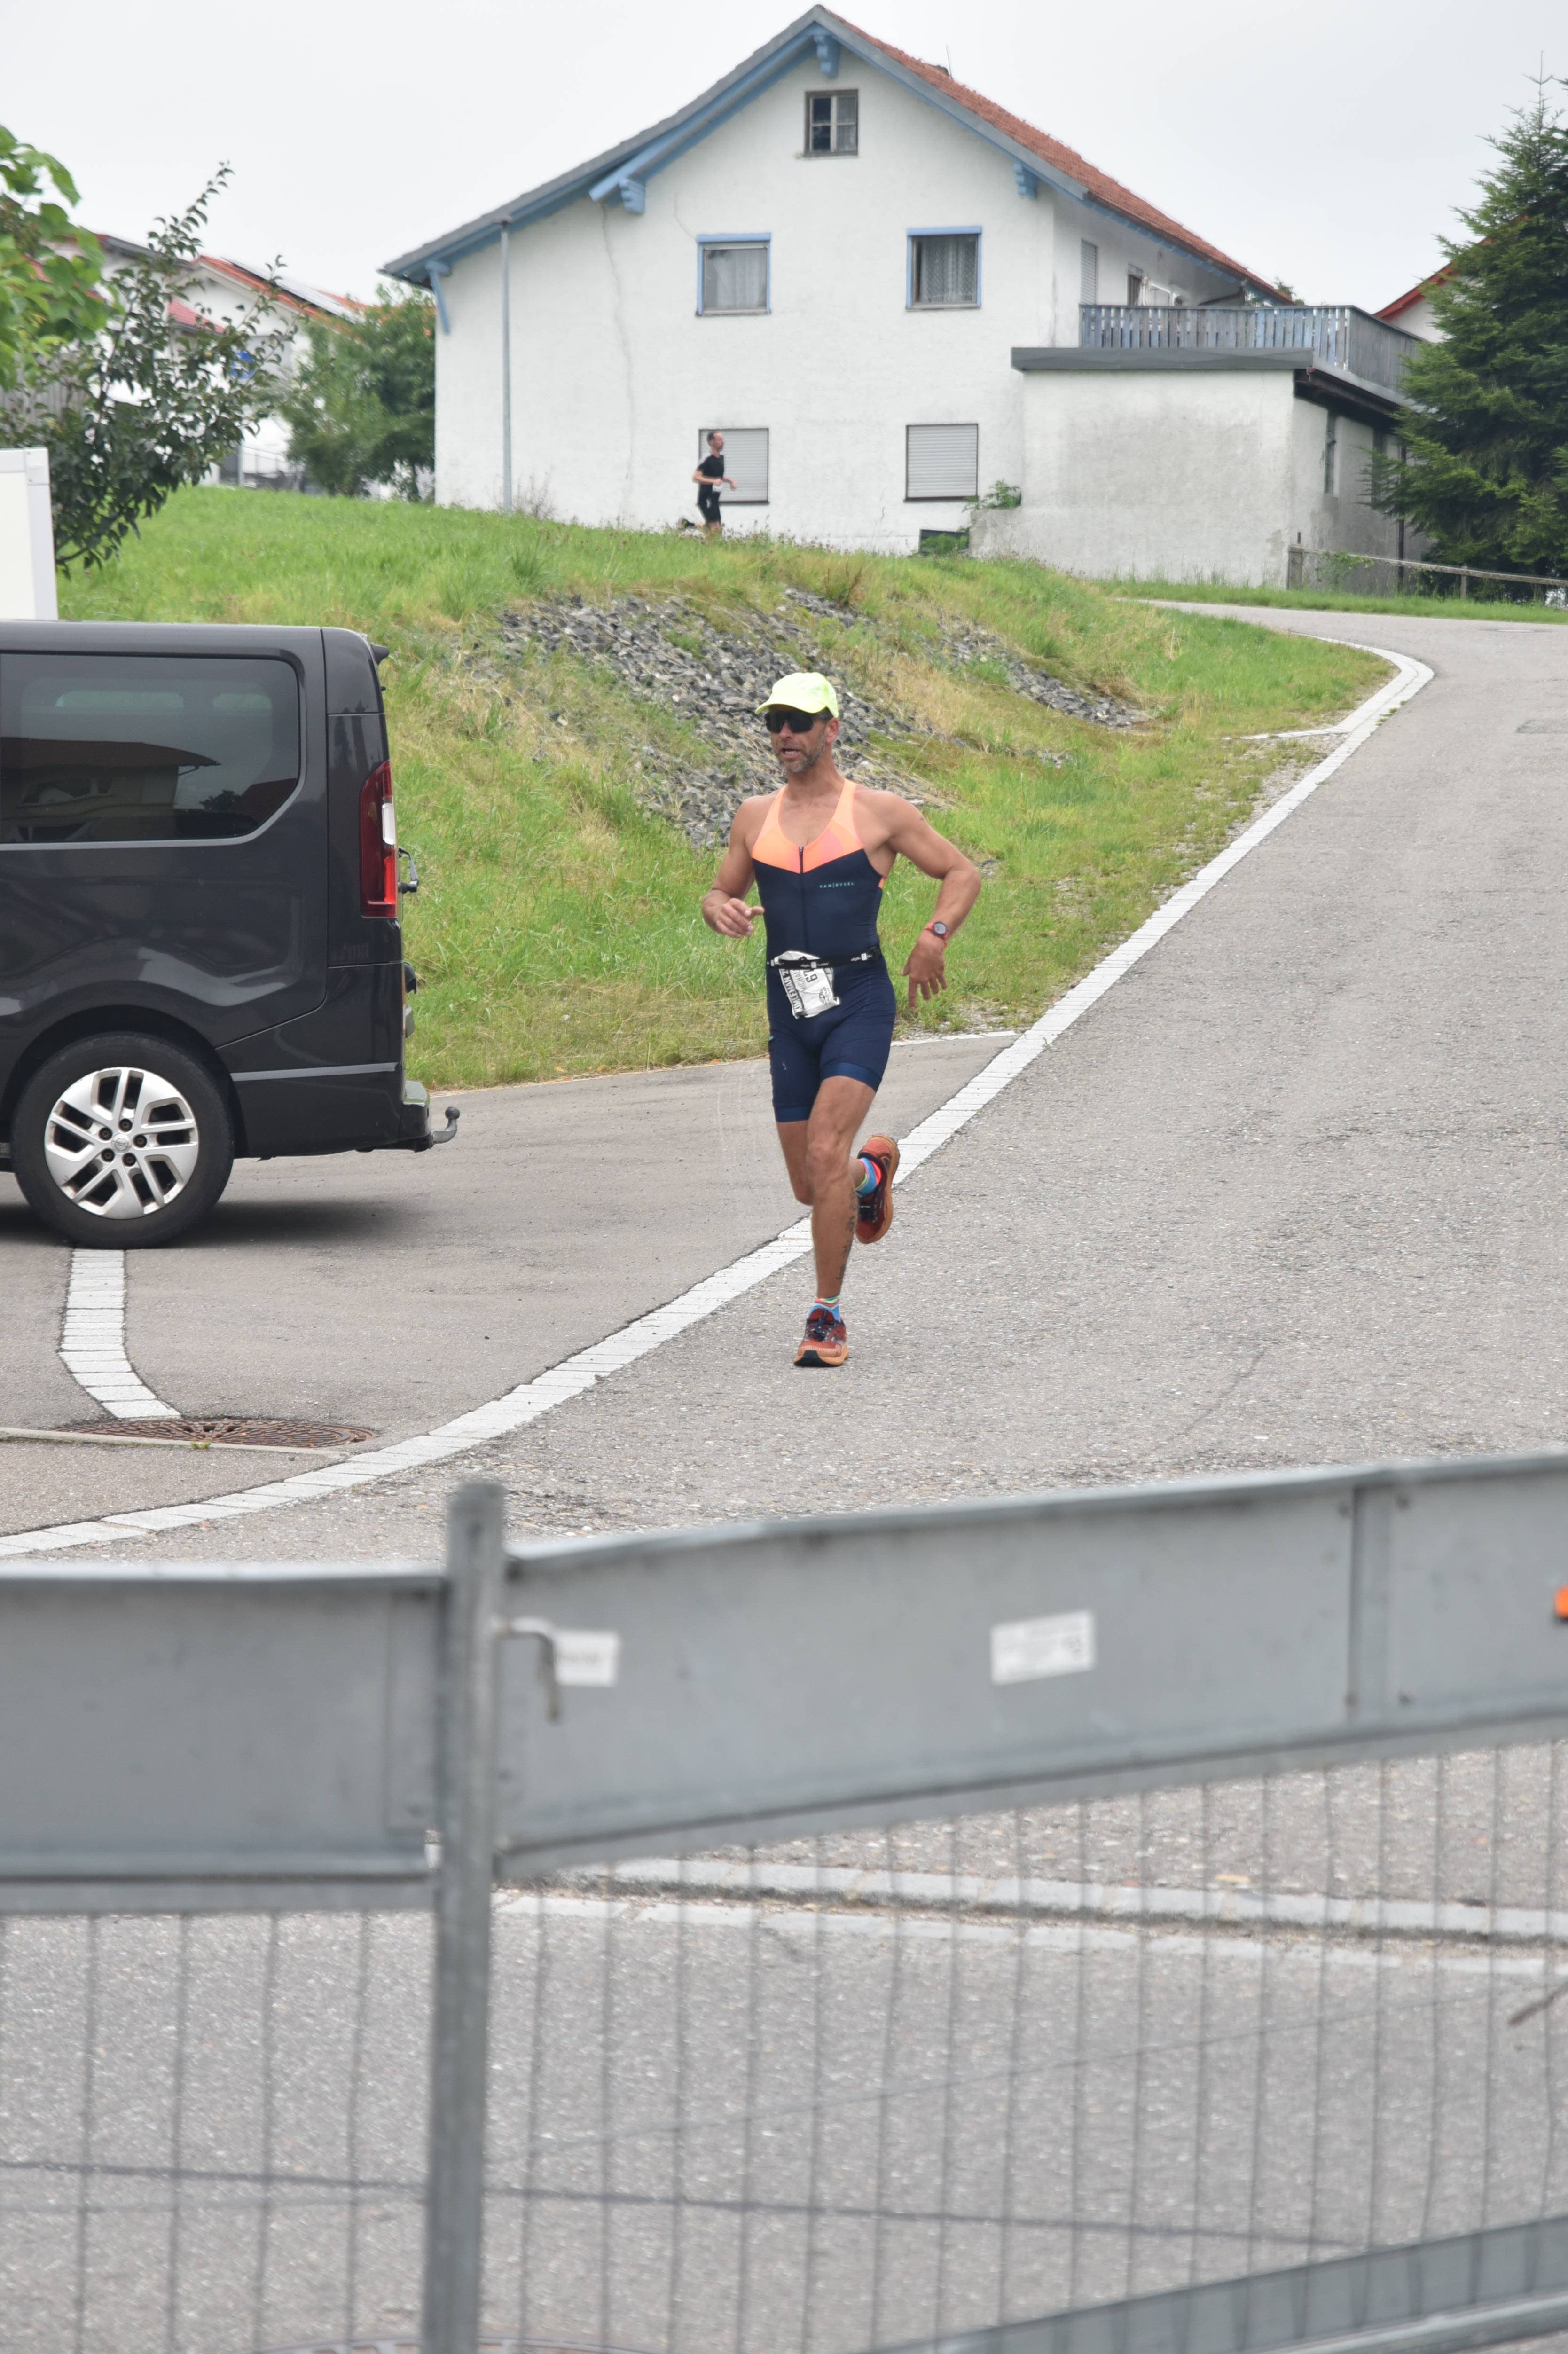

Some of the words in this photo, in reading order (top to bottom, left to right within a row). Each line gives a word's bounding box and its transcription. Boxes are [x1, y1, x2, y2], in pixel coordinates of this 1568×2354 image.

[793, 970, 807, 991] MICHAE
[803, 969, 818, 983] 67
[784, 976, 802, 1013] KIMLEMAN
